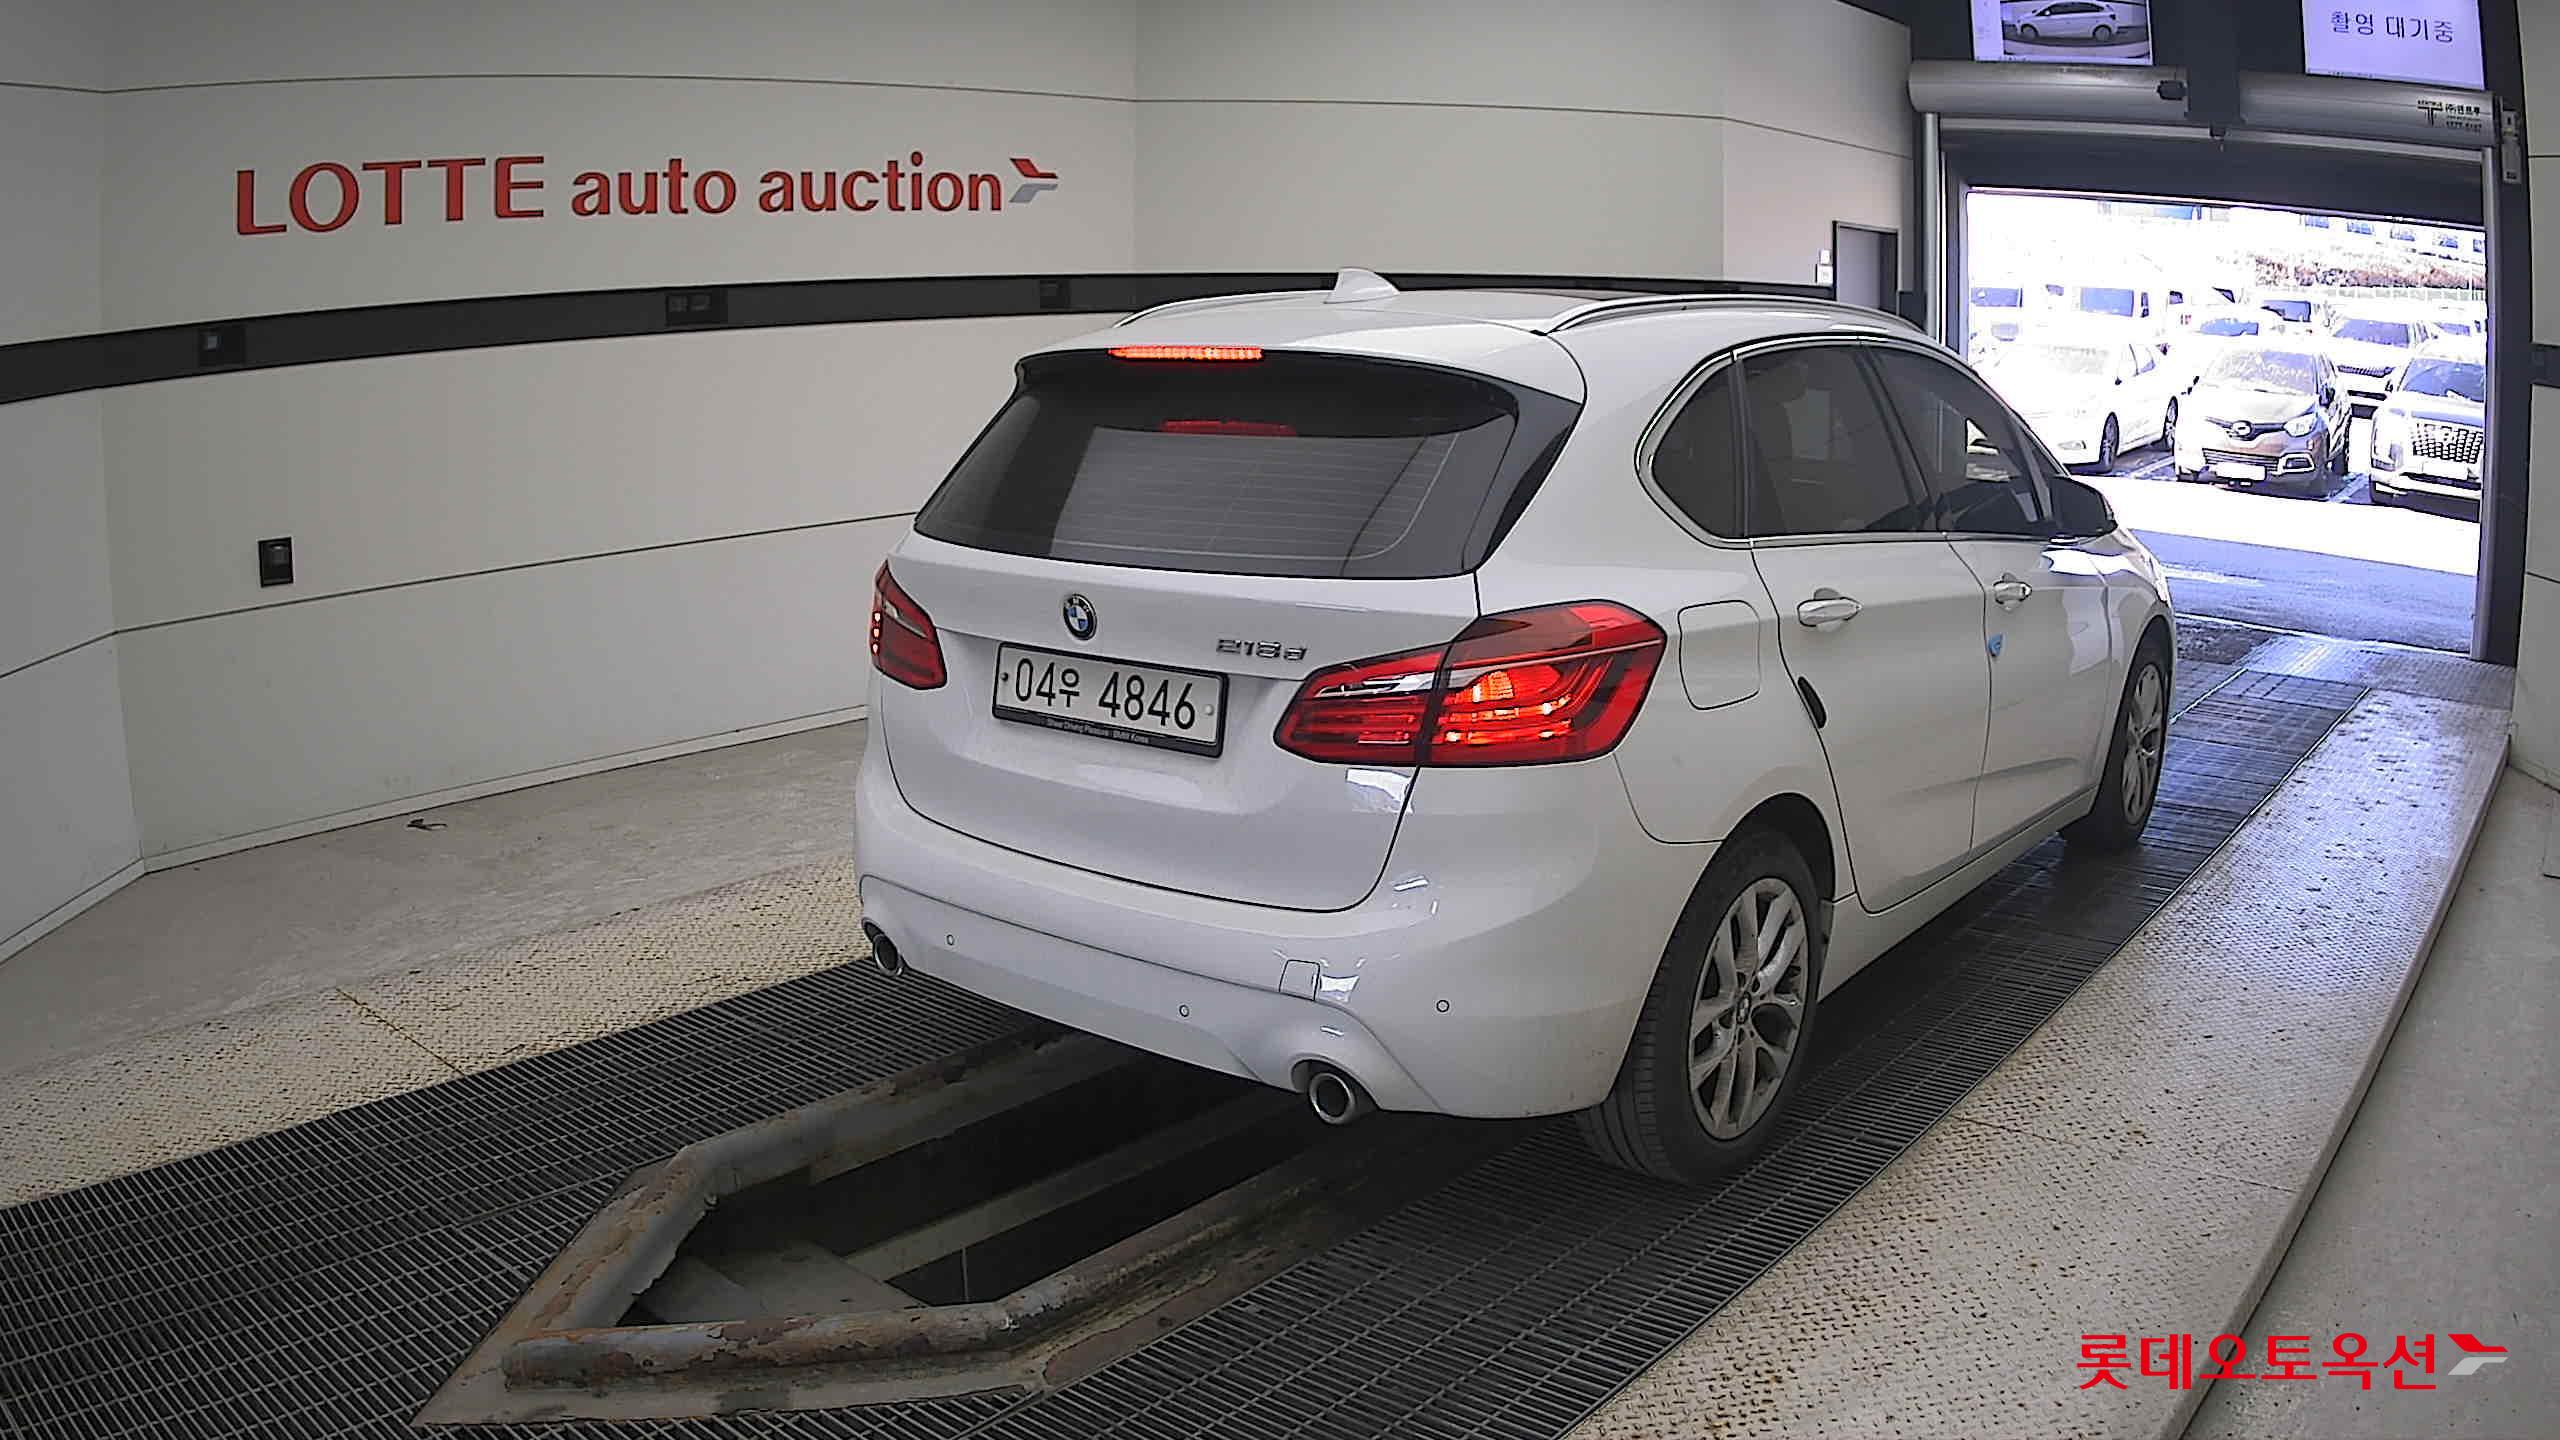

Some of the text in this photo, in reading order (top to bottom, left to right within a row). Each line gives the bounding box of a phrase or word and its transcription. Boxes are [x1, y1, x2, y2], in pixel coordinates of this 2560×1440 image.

[2331, 11, 2454, 44] 촬영 대기중
[237, 151, 1003, 236] LOTTE auto auction
[1015, 657, 1196, 730] 04우 4846
